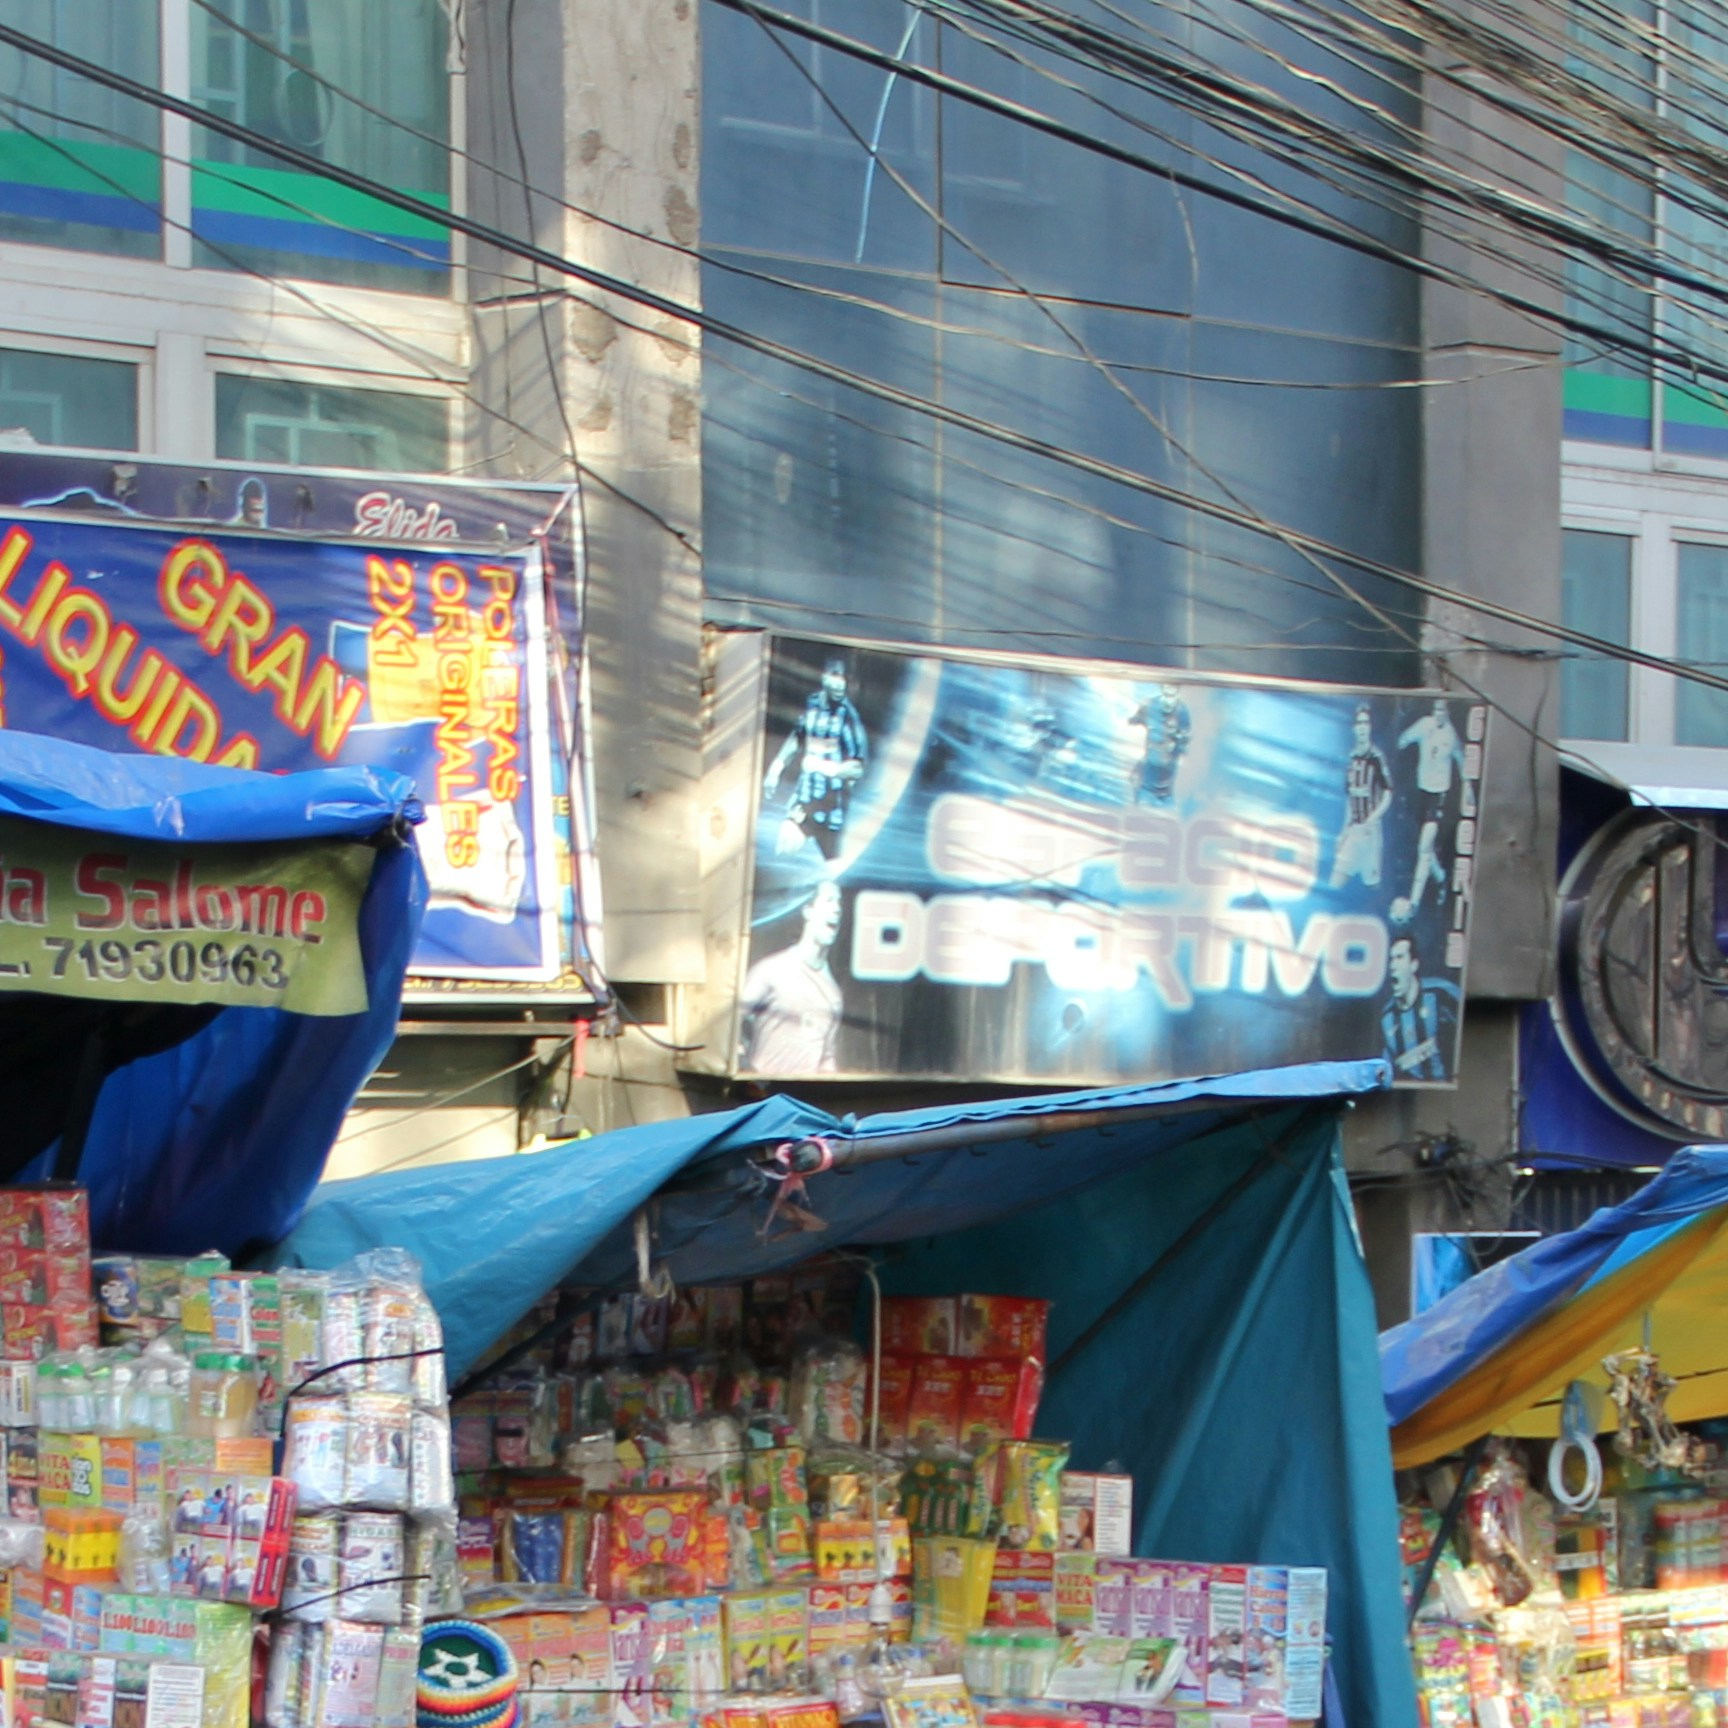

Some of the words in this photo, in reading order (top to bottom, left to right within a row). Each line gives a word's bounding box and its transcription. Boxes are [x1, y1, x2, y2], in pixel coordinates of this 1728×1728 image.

[158, 535, 366, 761] GRAN
[366, 554, 419, 672] 2X1
[479, 563, 522, 803] POLERAS
[430, 562, 480, 869] ORIGINALES
[42, 936, 290, 990] 71930963
[74, 852, 327, 945] Salome
